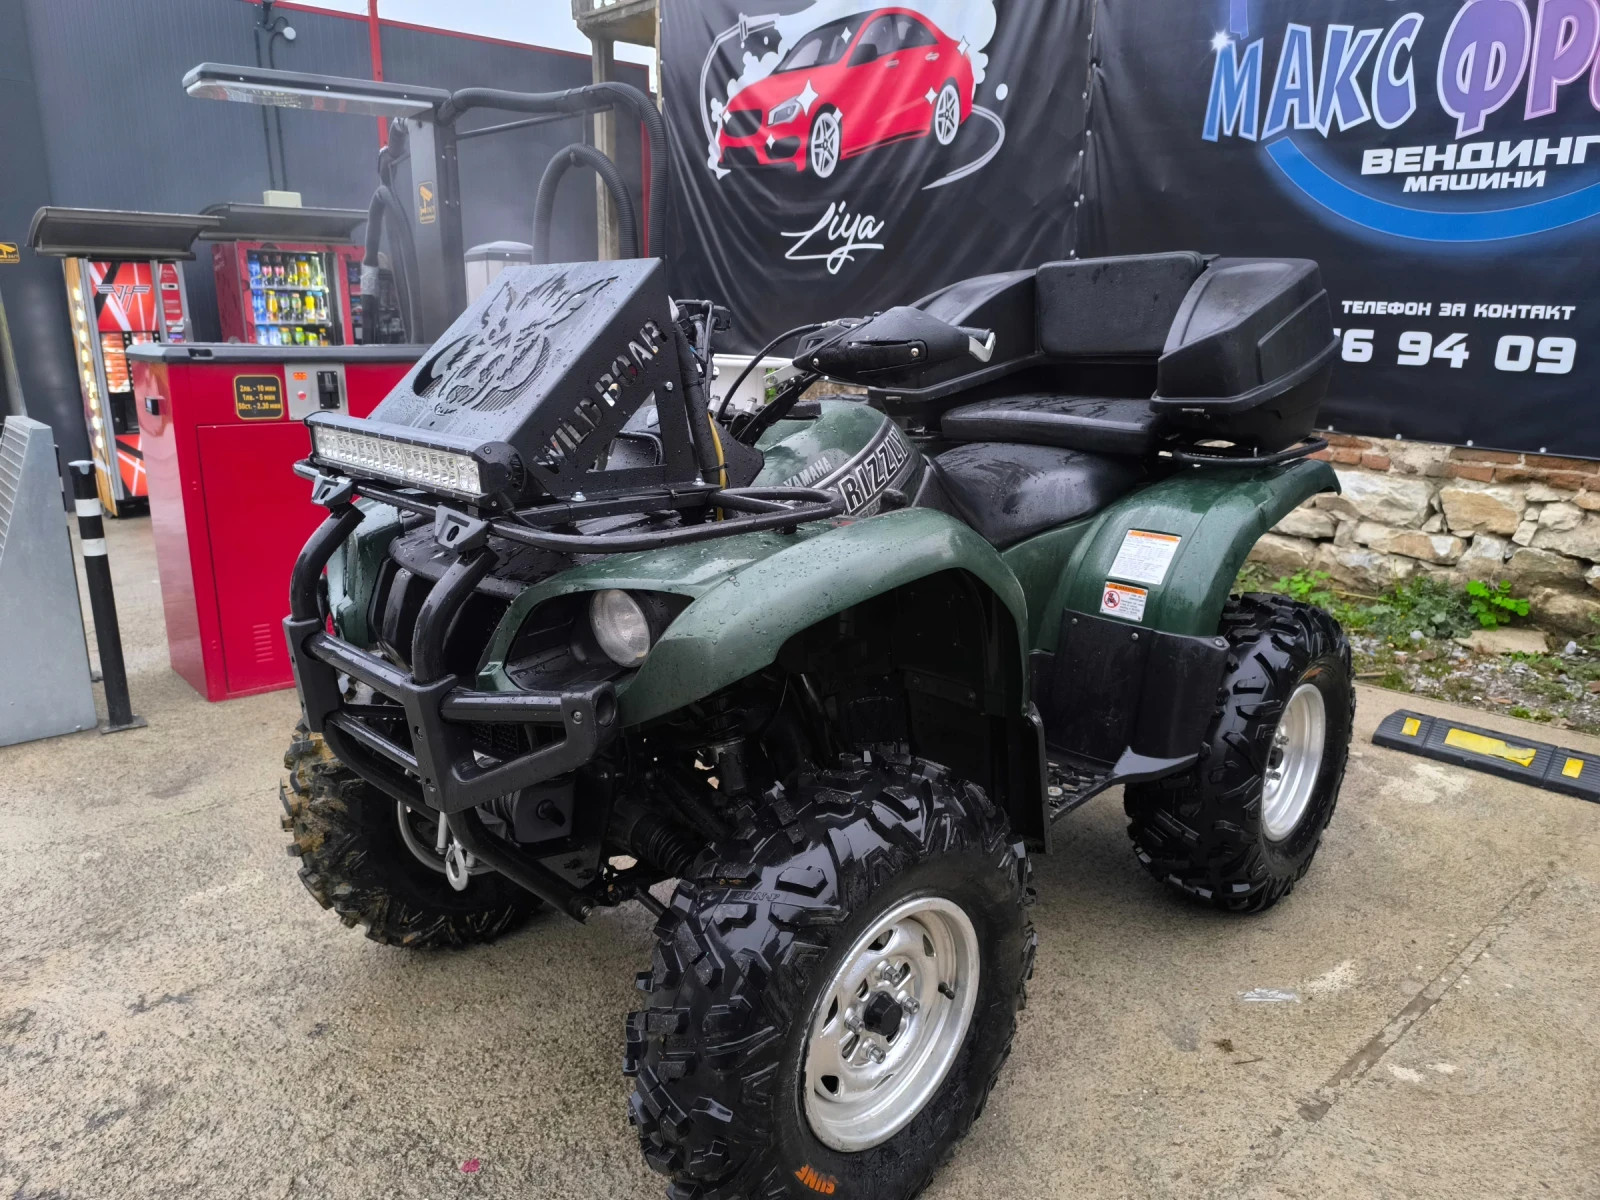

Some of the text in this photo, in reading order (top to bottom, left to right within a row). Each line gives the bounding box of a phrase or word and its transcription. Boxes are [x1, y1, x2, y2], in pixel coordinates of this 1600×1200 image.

[1202, 13, 1424, 142] МАКС
[1361, 136, 1600, 175] ВЕНДИНГ
[1402, 170, 1546, 193] МАШИНИ
[780, 200, 885, 275] Liya
[1341, 301, 1576, 320] ТЕЛЕФОН ЗА КОНТАКТ
[1397, 331, 1470, 369] 94
[1494, 335, 1577, 374] 09
[532, 320, 668, 474] WILD BOAR
[783, 456, 833, 487] YAMAHA
[828, 425, 909, 514] RIZZLY
